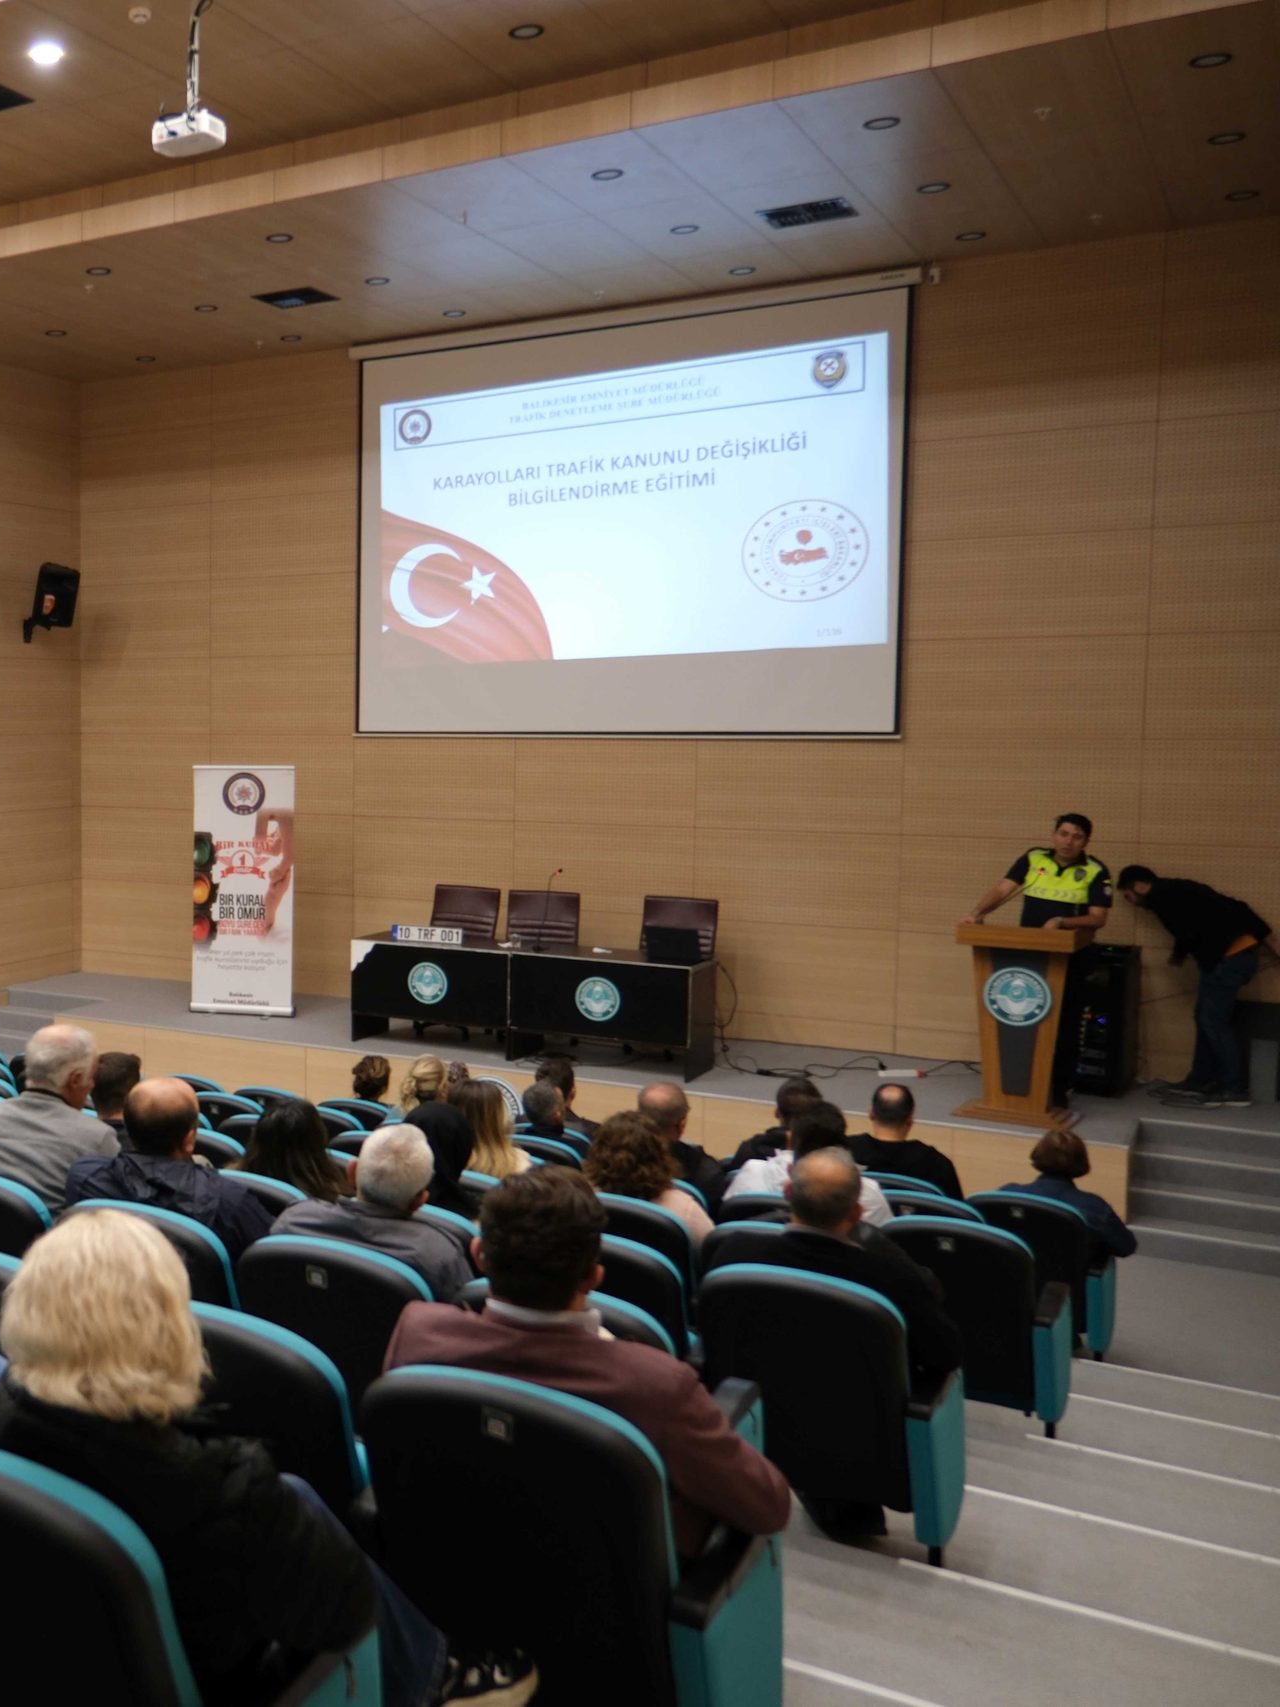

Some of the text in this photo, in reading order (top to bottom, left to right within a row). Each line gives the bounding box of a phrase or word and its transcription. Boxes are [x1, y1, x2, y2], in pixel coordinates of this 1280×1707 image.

[432, 431, 807, 491] KARAYOLLARI TRAFİK KANUNU DEĞİŞİKLİĞİ
[508, 467, 715, 507] BİLGİLENDİRME EĞİTİMİ
[236, 894, 265, 907] KURAL
[399, 927, 460, 942] 10 TRF 001
